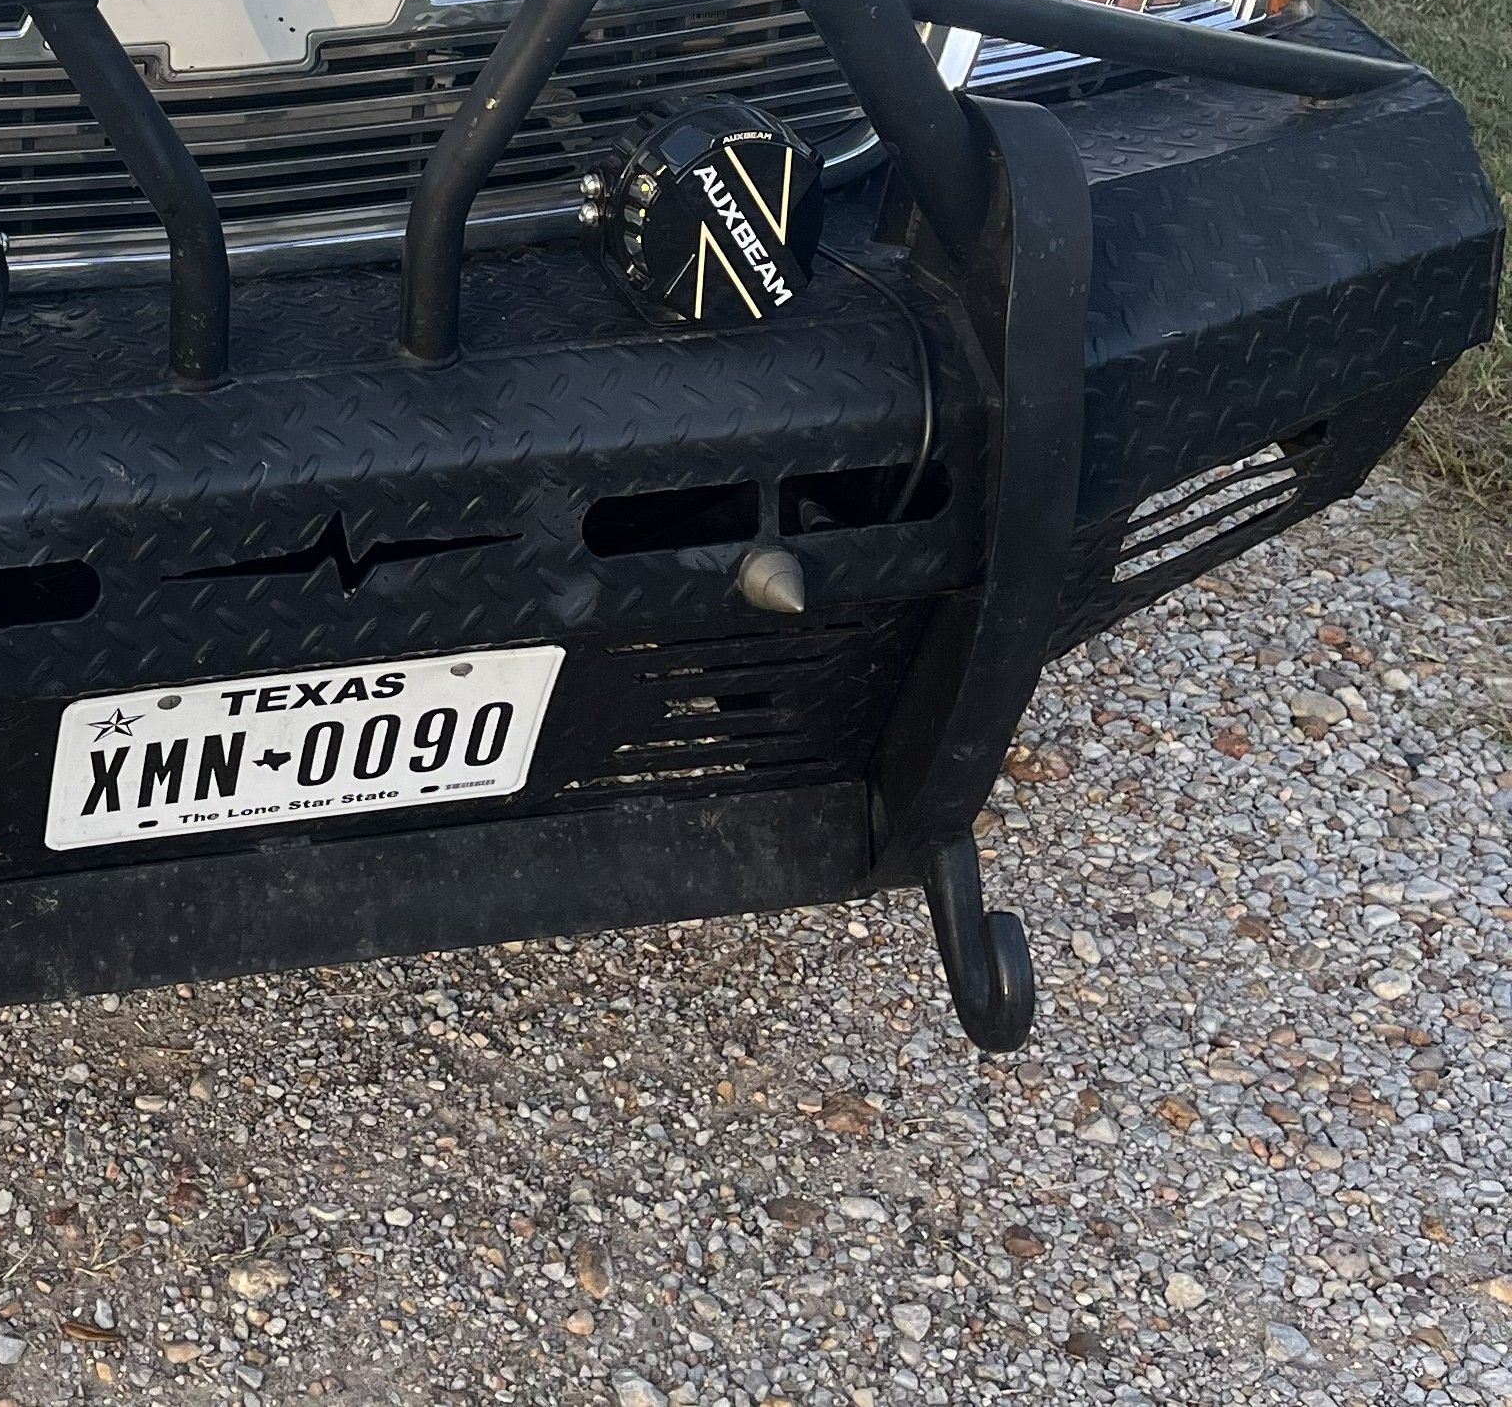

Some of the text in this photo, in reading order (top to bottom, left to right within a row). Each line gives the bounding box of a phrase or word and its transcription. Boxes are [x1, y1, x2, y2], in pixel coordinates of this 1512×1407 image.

[722, 131, 773, 144] AUXBEAM
[692, 165, 793, 307] AUXBEAM
[220, 672, 407, 716] TEXAS
[178, 789, 401, 824] The Lone Star State
